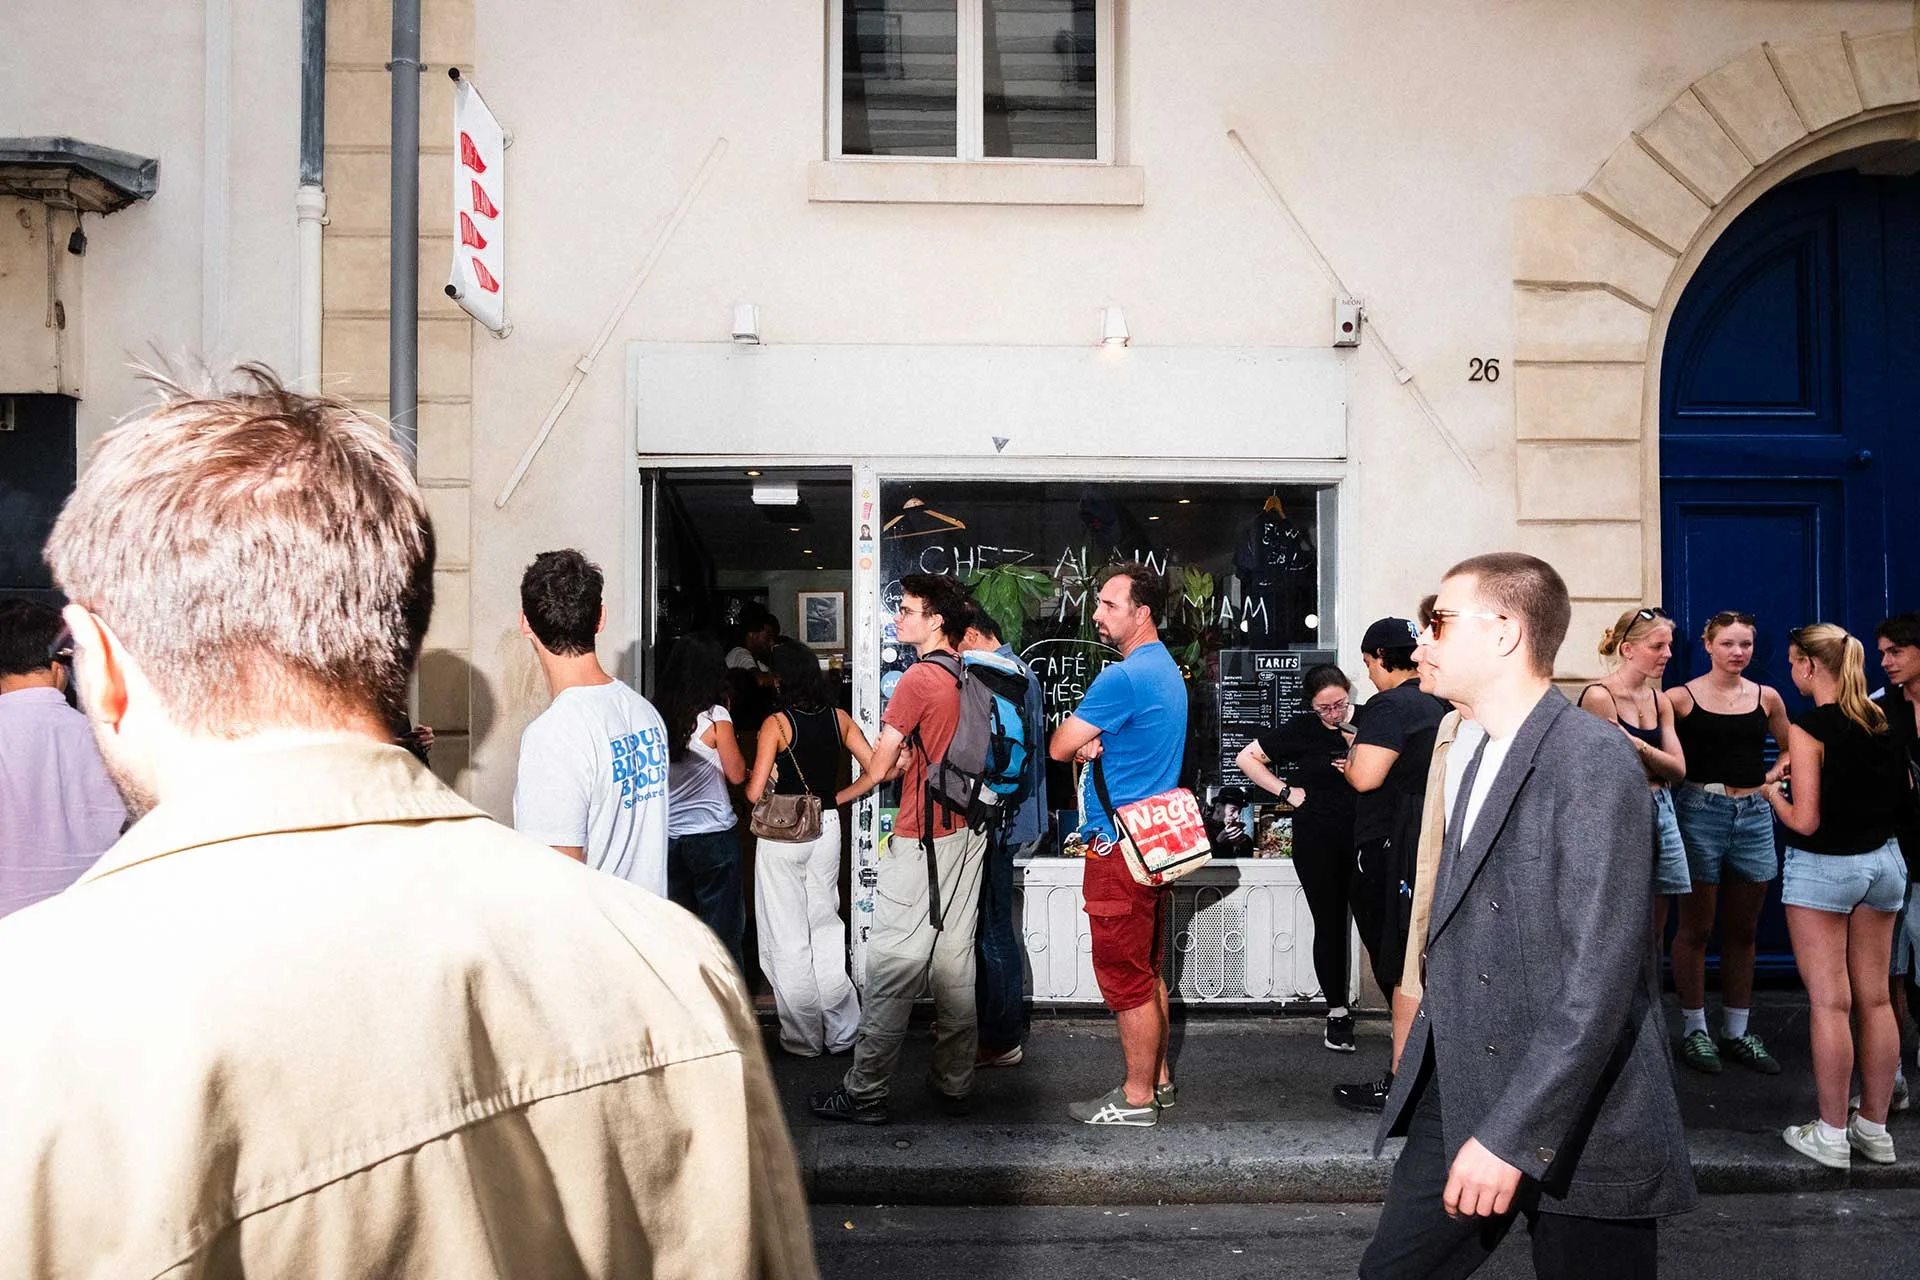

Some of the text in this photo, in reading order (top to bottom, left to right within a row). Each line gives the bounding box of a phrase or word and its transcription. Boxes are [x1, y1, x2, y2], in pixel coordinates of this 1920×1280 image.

[1468, 357, 1500, 383] 26
[920, 545, 1035, 580] CHEZ
[1183, 594, 1269, 635] MIAM
[1028, 652, 1087, 677] CAFÉ
[1257, 657, 1298, 669] TARIFS
[1043, 676, 1085, 706] HÉS
